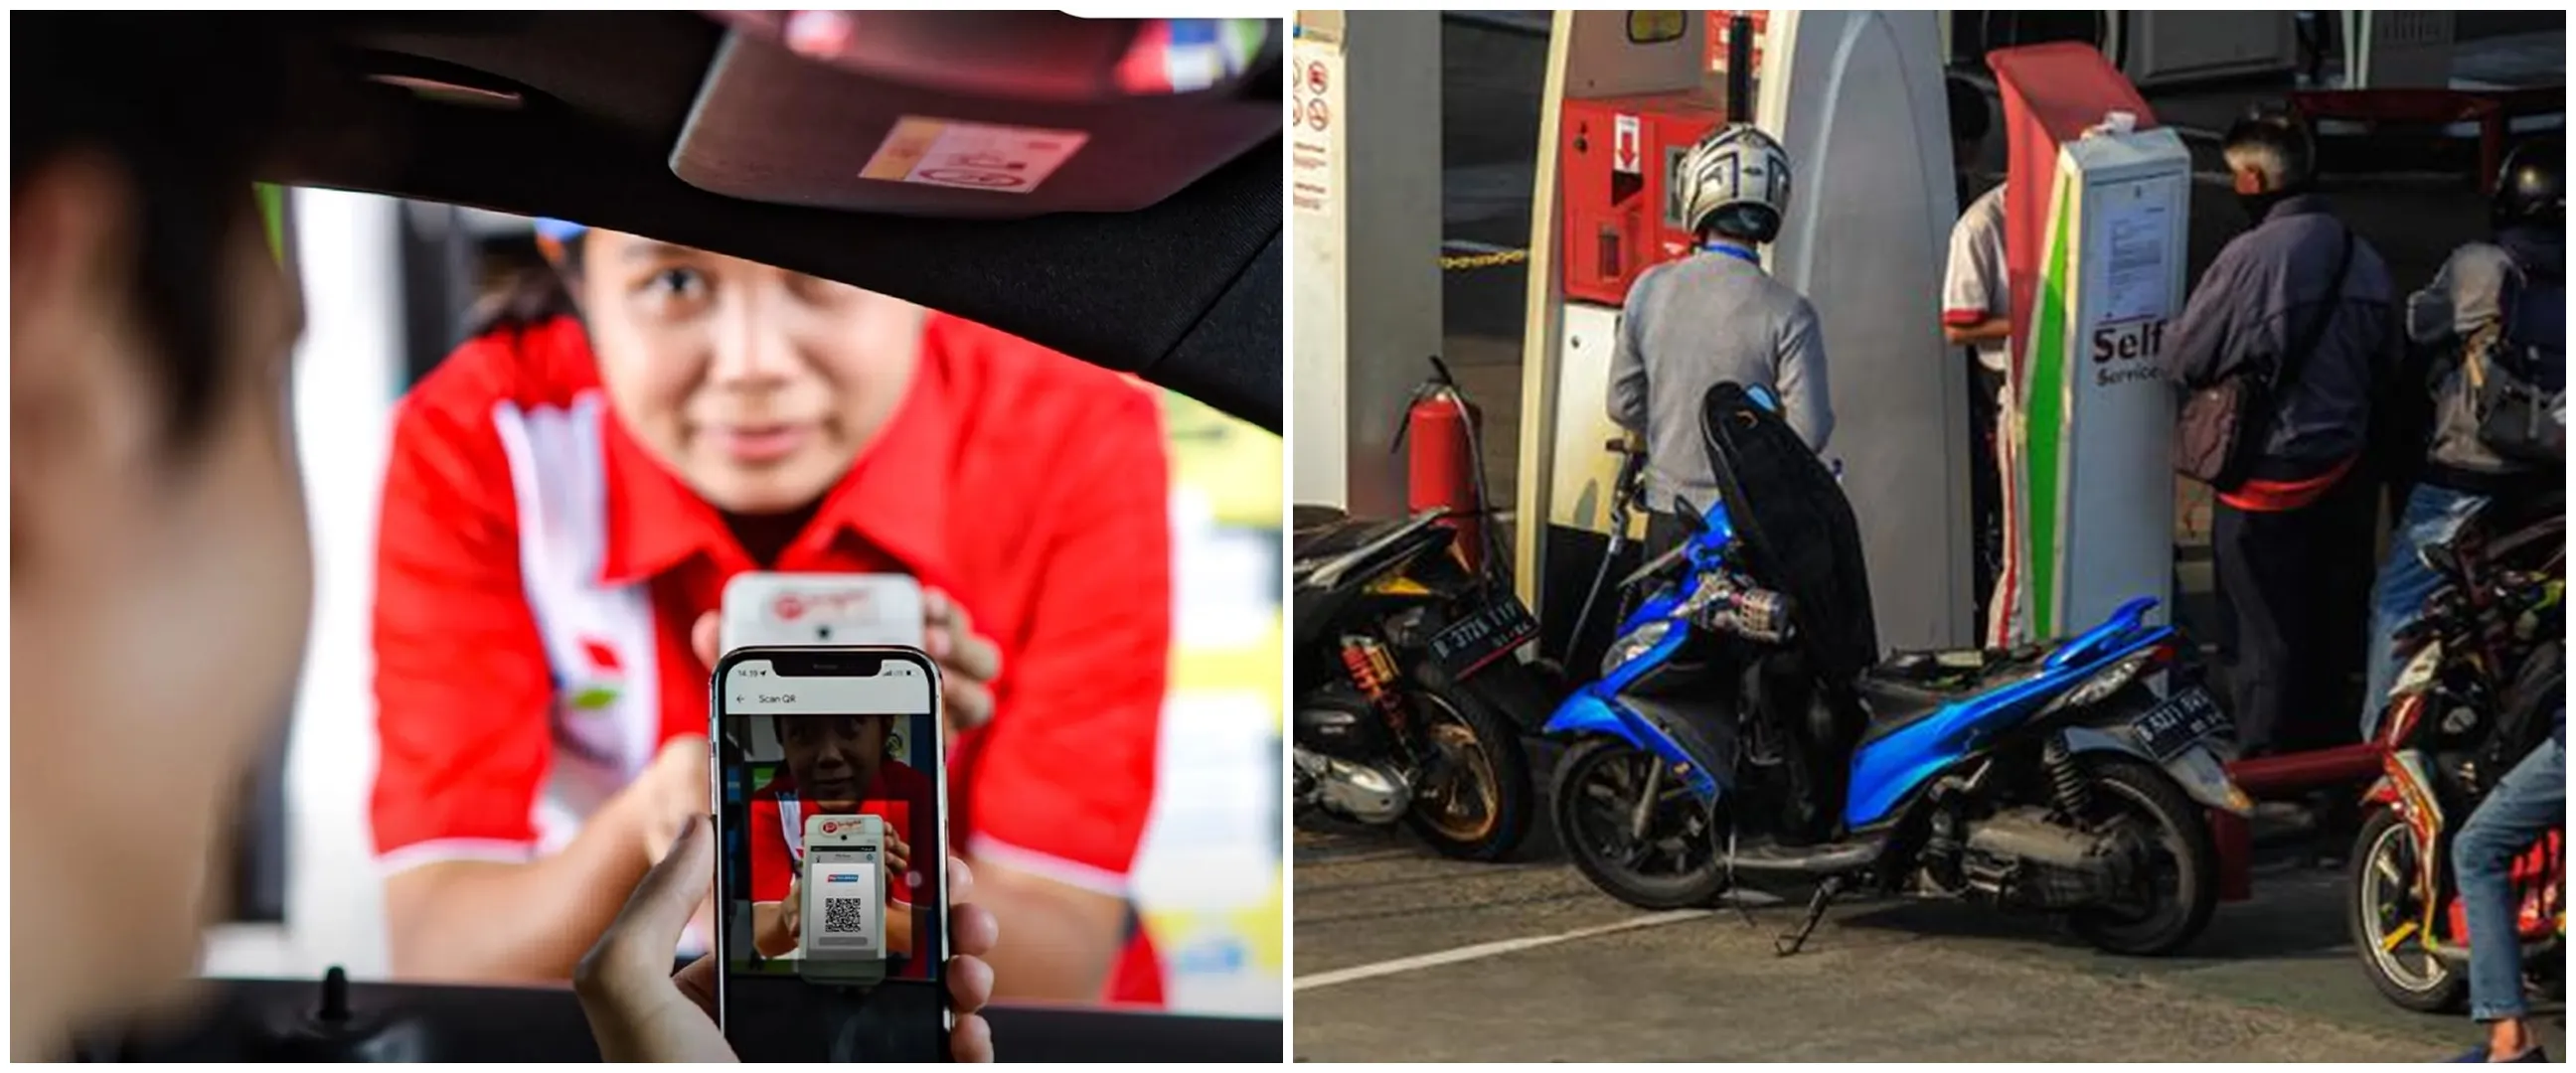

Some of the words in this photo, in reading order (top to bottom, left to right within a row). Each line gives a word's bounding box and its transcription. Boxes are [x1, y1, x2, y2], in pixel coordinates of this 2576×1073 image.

[2093, 319, 2168, 364] Self
[758, 694, 781, 703] Scan
[782, 694, 796, 703] QR
